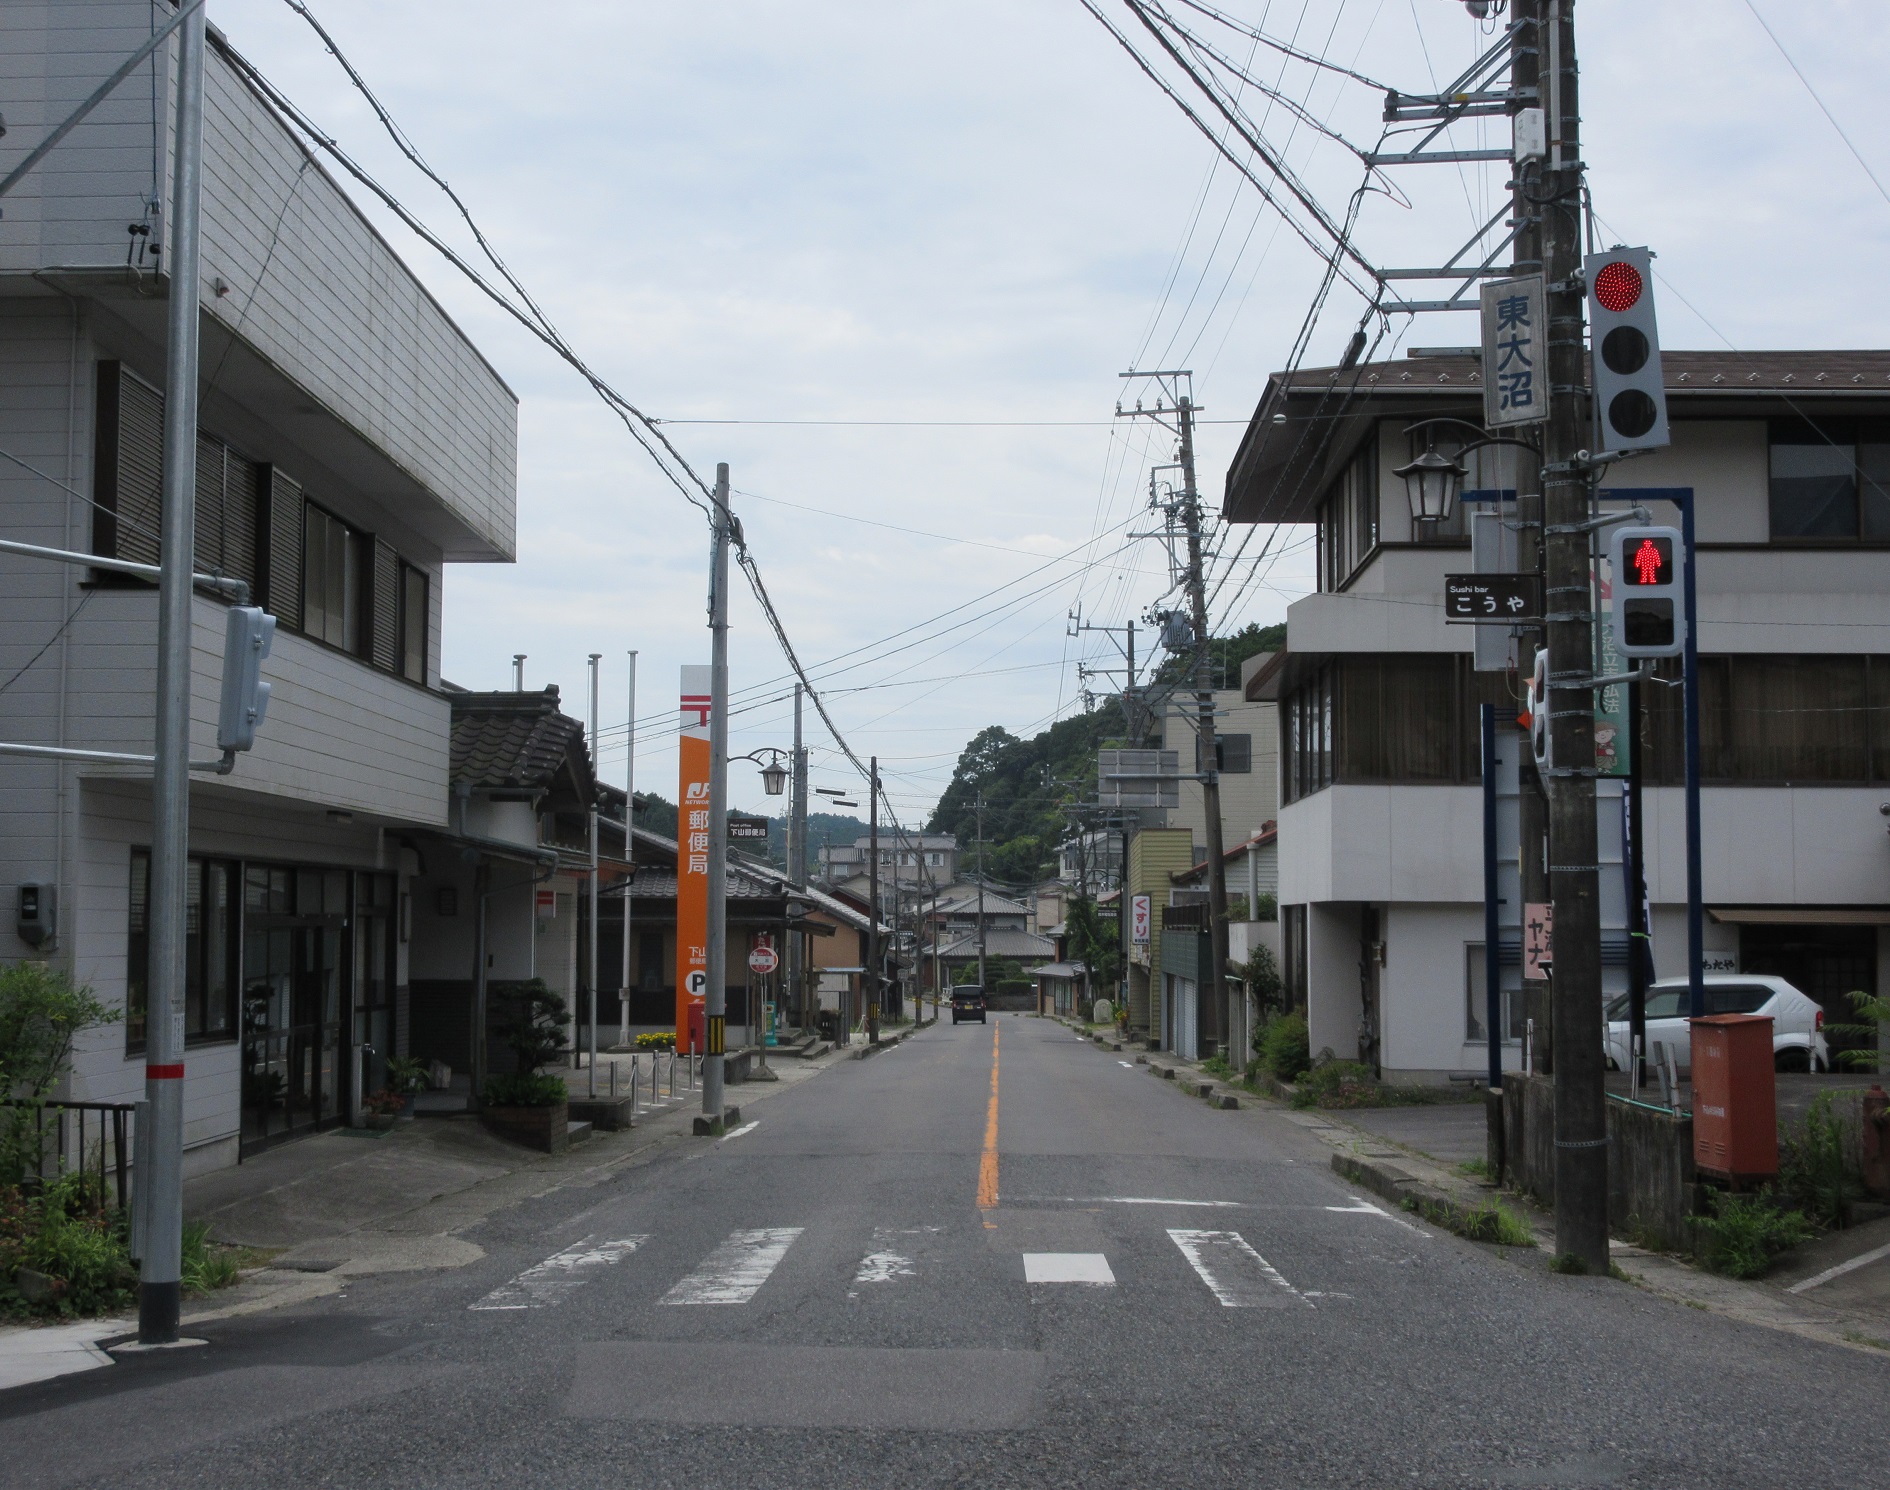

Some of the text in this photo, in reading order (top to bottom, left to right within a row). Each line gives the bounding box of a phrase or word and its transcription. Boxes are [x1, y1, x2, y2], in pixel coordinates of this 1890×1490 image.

[1496, 294, 1533, 412] 東大沼
[1450, 585, 1489, 593] Sushi bar
[1456, 595, 1525, 613] こうや
[687, 809, 709, 875] 郵便局
[1135, 899, 1147, 937] くすり
[1527, 917, 1544, 966] ヤナ
